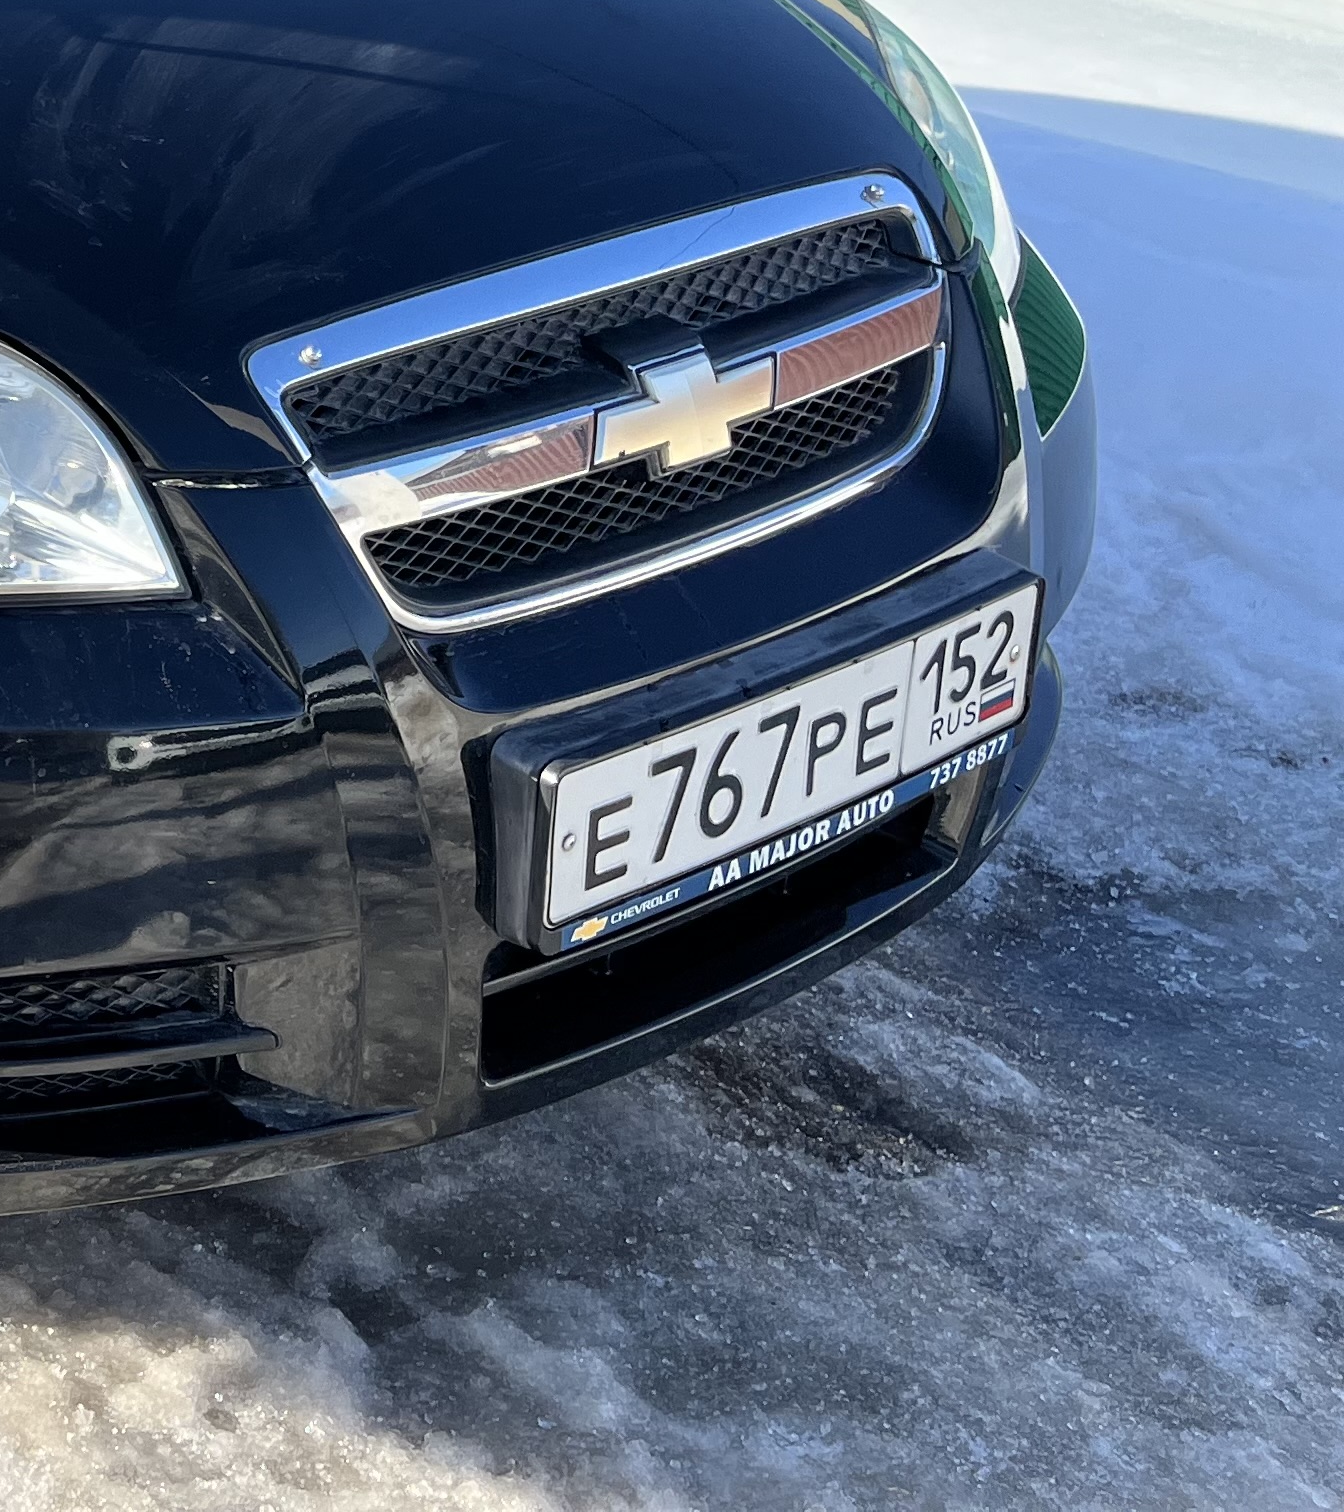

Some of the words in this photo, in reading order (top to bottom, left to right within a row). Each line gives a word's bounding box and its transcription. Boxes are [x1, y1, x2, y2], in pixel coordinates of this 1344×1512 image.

[919, 610, 1015, 715] 152
[929, 701, 977, 746] RUS
[928, 759, 962, 789] 737
[965, 733, 1009, 771] 8877
[708, 857, 743, 891] AA
[748, 820, 830, 874] MAJOR
[836, 788, 896, 835] AUTO
[610, 887, 681, 925] CHEVROLET
